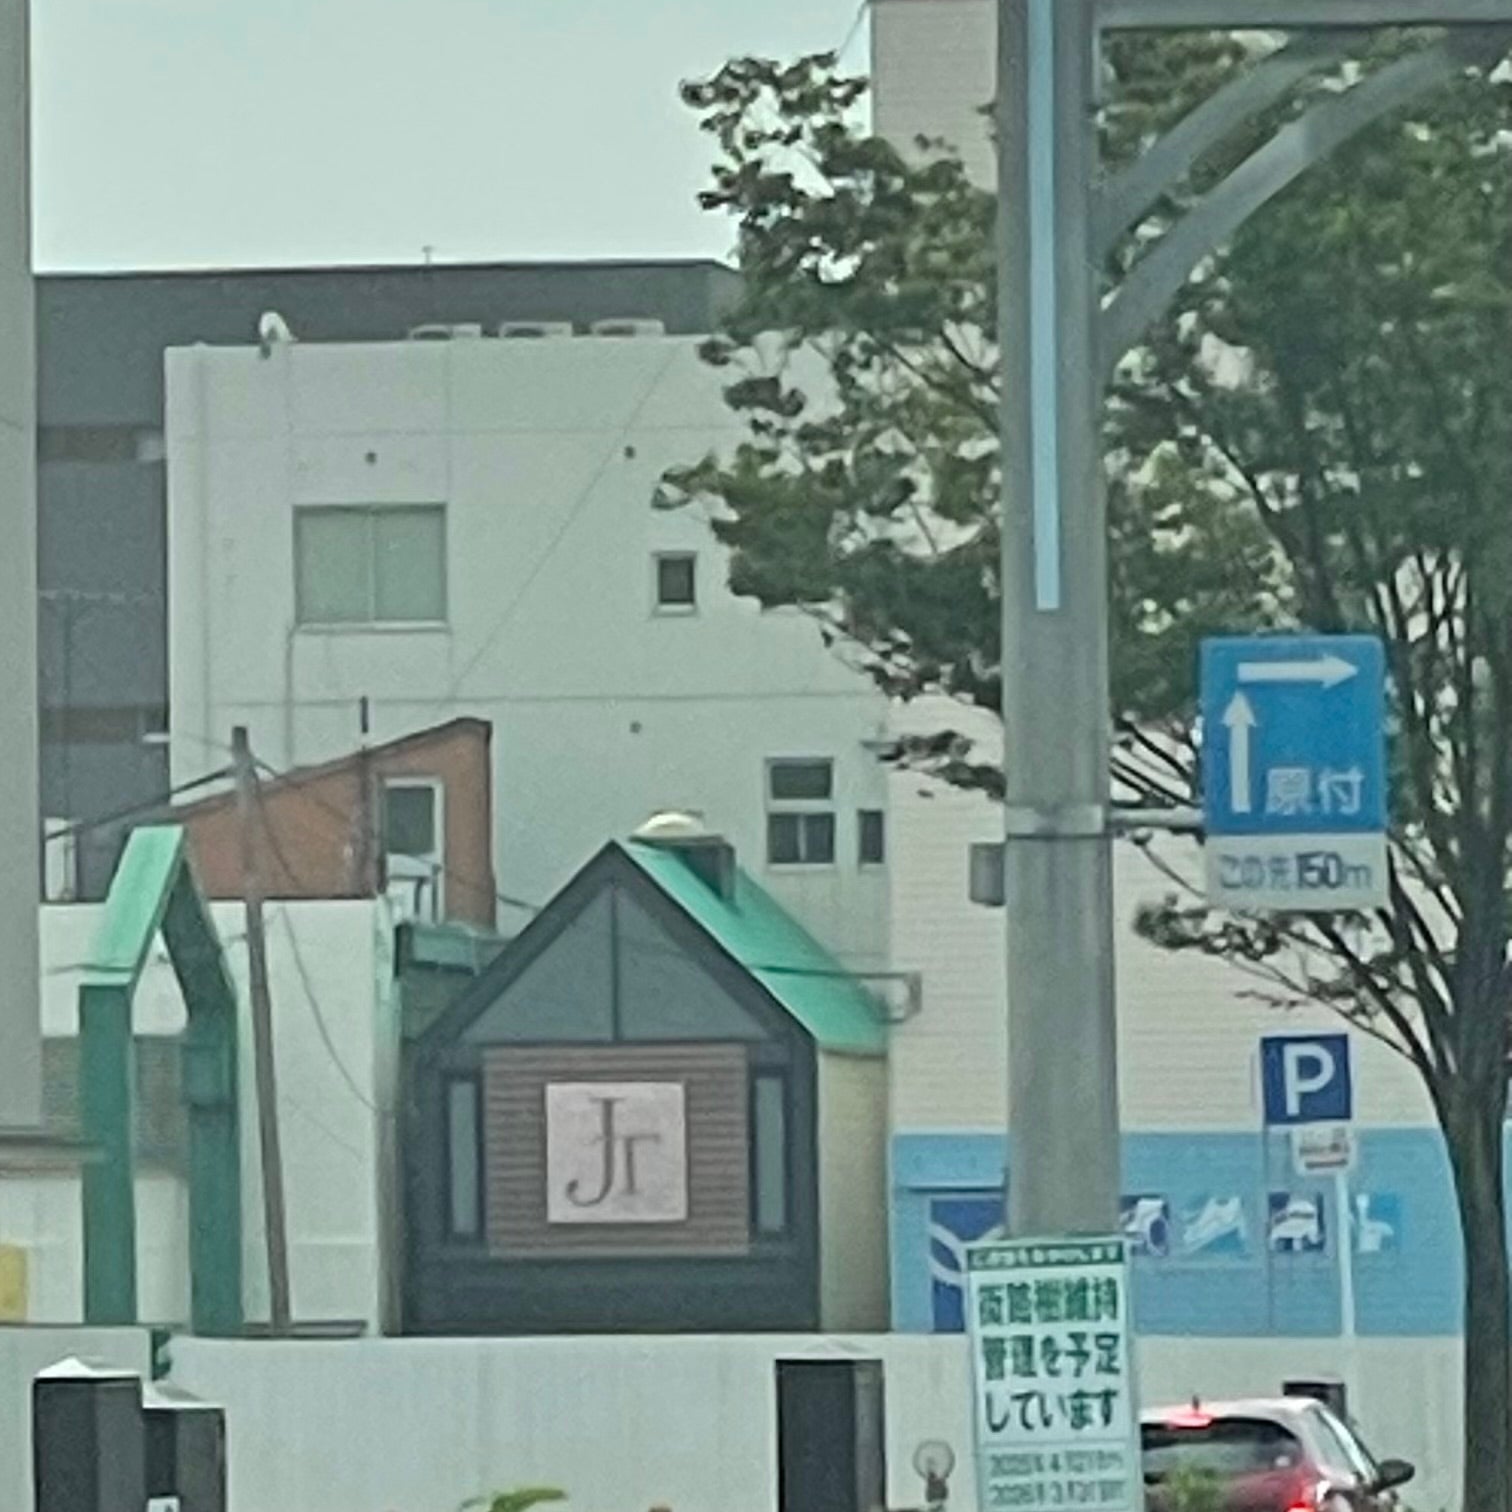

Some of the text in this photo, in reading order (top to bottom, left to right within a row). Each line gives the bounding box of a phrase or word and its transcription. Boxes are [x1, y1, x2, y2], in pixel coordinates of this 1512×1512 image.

[1283, 1042, 1335, 1116] P
[986, 1390, 1119, 1432] しています
